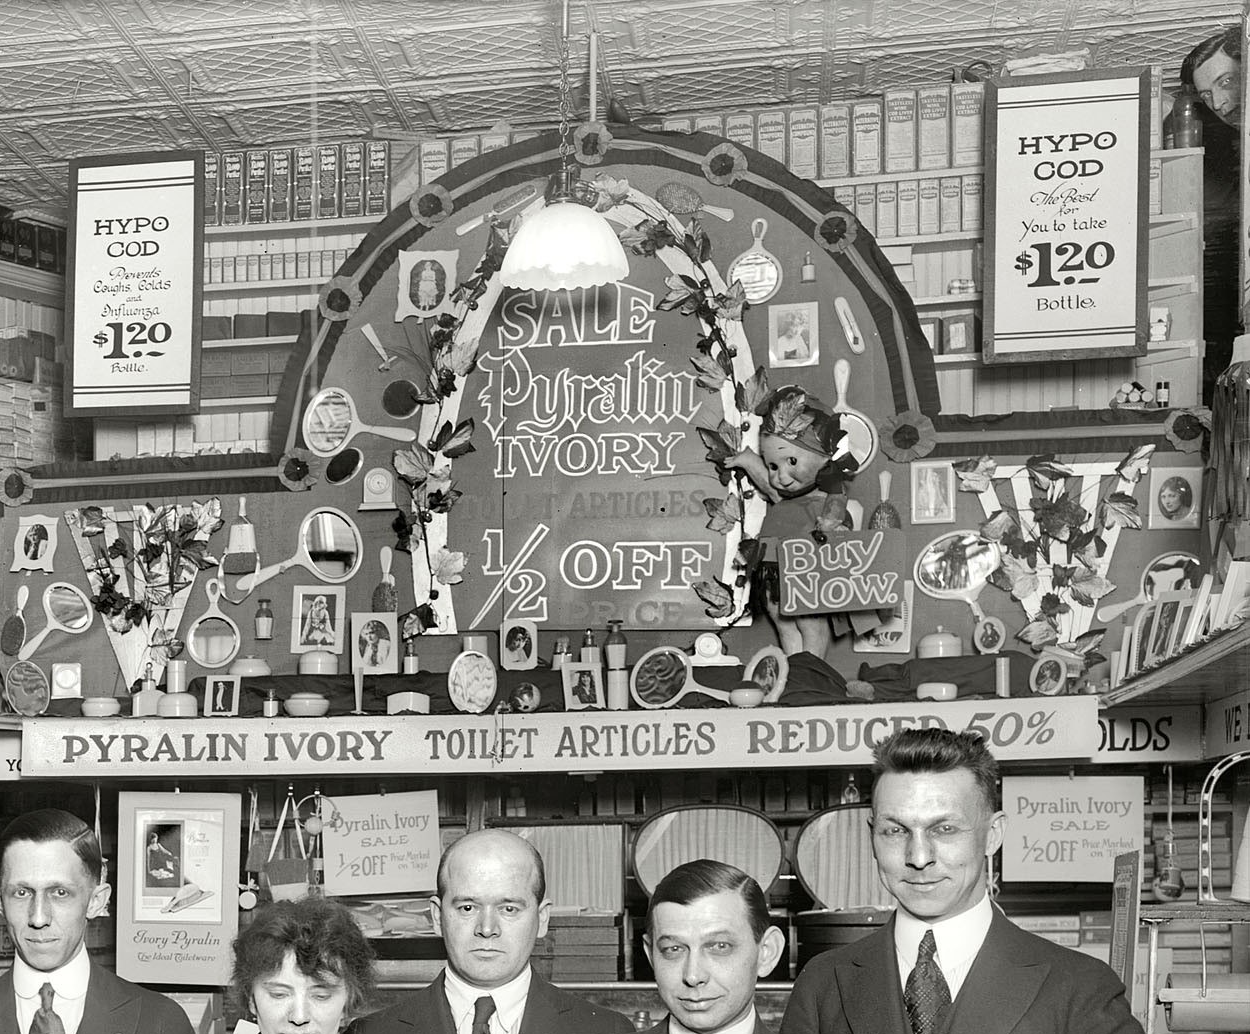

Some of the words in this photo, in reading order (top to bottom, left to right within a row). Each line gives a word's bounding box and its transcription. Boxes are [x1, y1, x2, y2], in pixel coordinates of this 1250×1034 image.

[1018, 131, 1118, 155] HYPO
[1034, 159, 1104, 181] COD
[1030, 182, 1067, 206] The
[1060, 187, 1100, 204] Best
[1052, 203, 1080, 217] for
[94, 216, 170, 236] HYPO
[1019, 218, 1049, 242] You
[1053, 219, 1066, 232] to
[1074, 217, 1108, 231] take
[107, 241, 160, 258] COD
[109, 266, 162, 281] Prevents
[1014, 241, 1116, 288] $1.20
[138, 278, 172, 291] Colds
[125, 295, 143, 303] and
[1037, 294, 1097, 312] Bottle.
[101, 303, 161, 320] Influenza
[498, 282, 657, 349] SALE
[92, 322, 172, 359] $1.20
[477, 348, 703, 441] Pyralin
[494, 432, 686, 478] IVORY
[559, 539, 712, 590] OFF
[782, 531, 884, 575] Buy
[1224, 704, 1242, 744] WE
[62, 730, 248, 763] PYRALIN
[263, 729, 393, 763] IVORY
[424, 727, 539, 760] TOILET
[554, 721, 716, 759] ARTICLES
[965, 710, 1057, 748] 50%
[1017, 796, 1083, 818] Pyralin
[1087, 796, 1133, 817] Ivory
[332, 812, 391, 837] Pyralin
[394, 812, 430, 831] Ivory
[1050, 820, 1111, 831] SALE
[361, 834, 409, 847] SALE
[1045, 840, 1079, 863] OFF
[1082, 838, 1102, 849] Price
[1103, 837, 1135, 849] Marked
[361, 855, 388, 876] OFF
[406, 849, 430, 861] Marked
[1090, 850, 1104, 858] on
[133, 929, 169, 950] Ivory
[171, 930, 221, 950] Pyralin
[137, 952, 152, 963] The
[153, 953, 173, 962] Ideal
[174, 952, 216, 964] Toiletware
